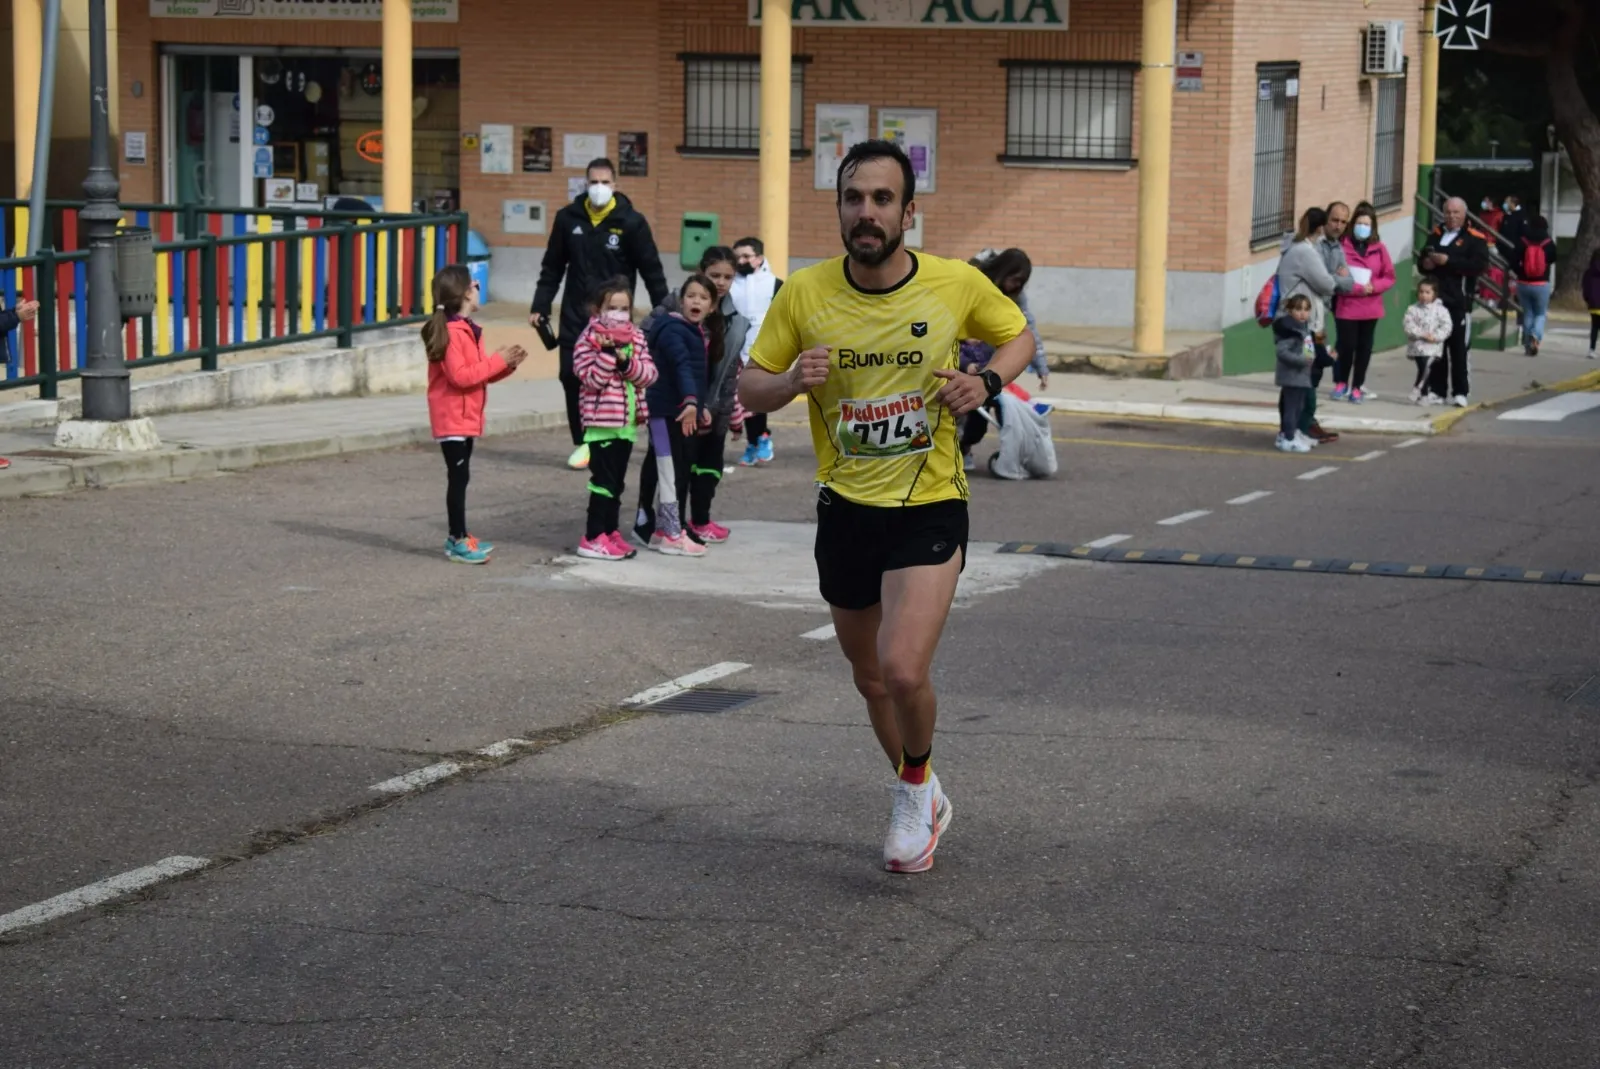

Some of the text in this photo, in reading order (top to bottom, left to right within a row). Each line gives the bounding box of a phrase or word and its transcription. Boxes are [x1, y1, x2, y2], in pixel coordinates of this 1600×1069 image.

[839, 349, 923, 369] RUN & GO
[854, 415, 912, 445] 774
